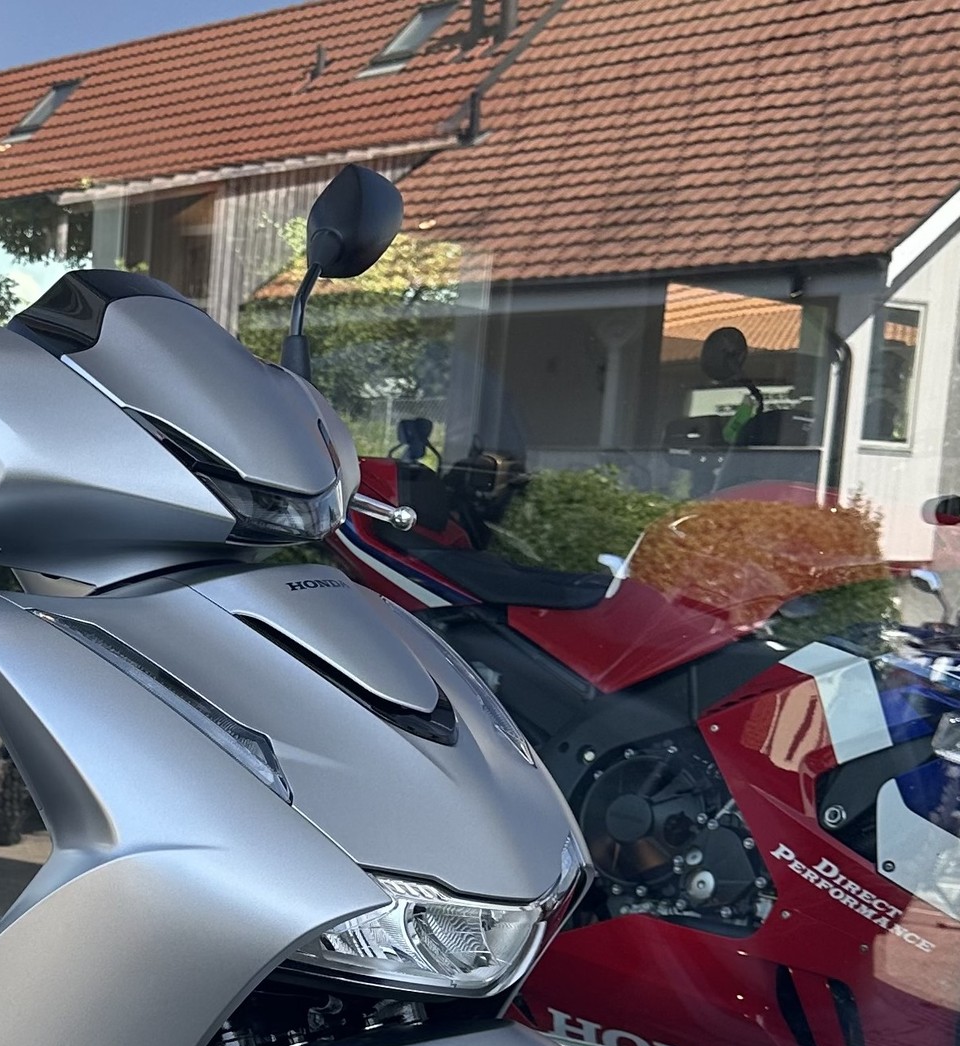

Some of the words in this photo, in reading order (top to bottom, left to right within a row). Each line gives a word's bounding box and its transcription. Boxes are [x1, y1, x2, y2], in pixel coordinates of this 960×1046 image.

[285, 579, 351, 592] HONDA
[770, 843, 936, 953] PERFORMANCE
[813, 857, 903, 919] DIRECT
